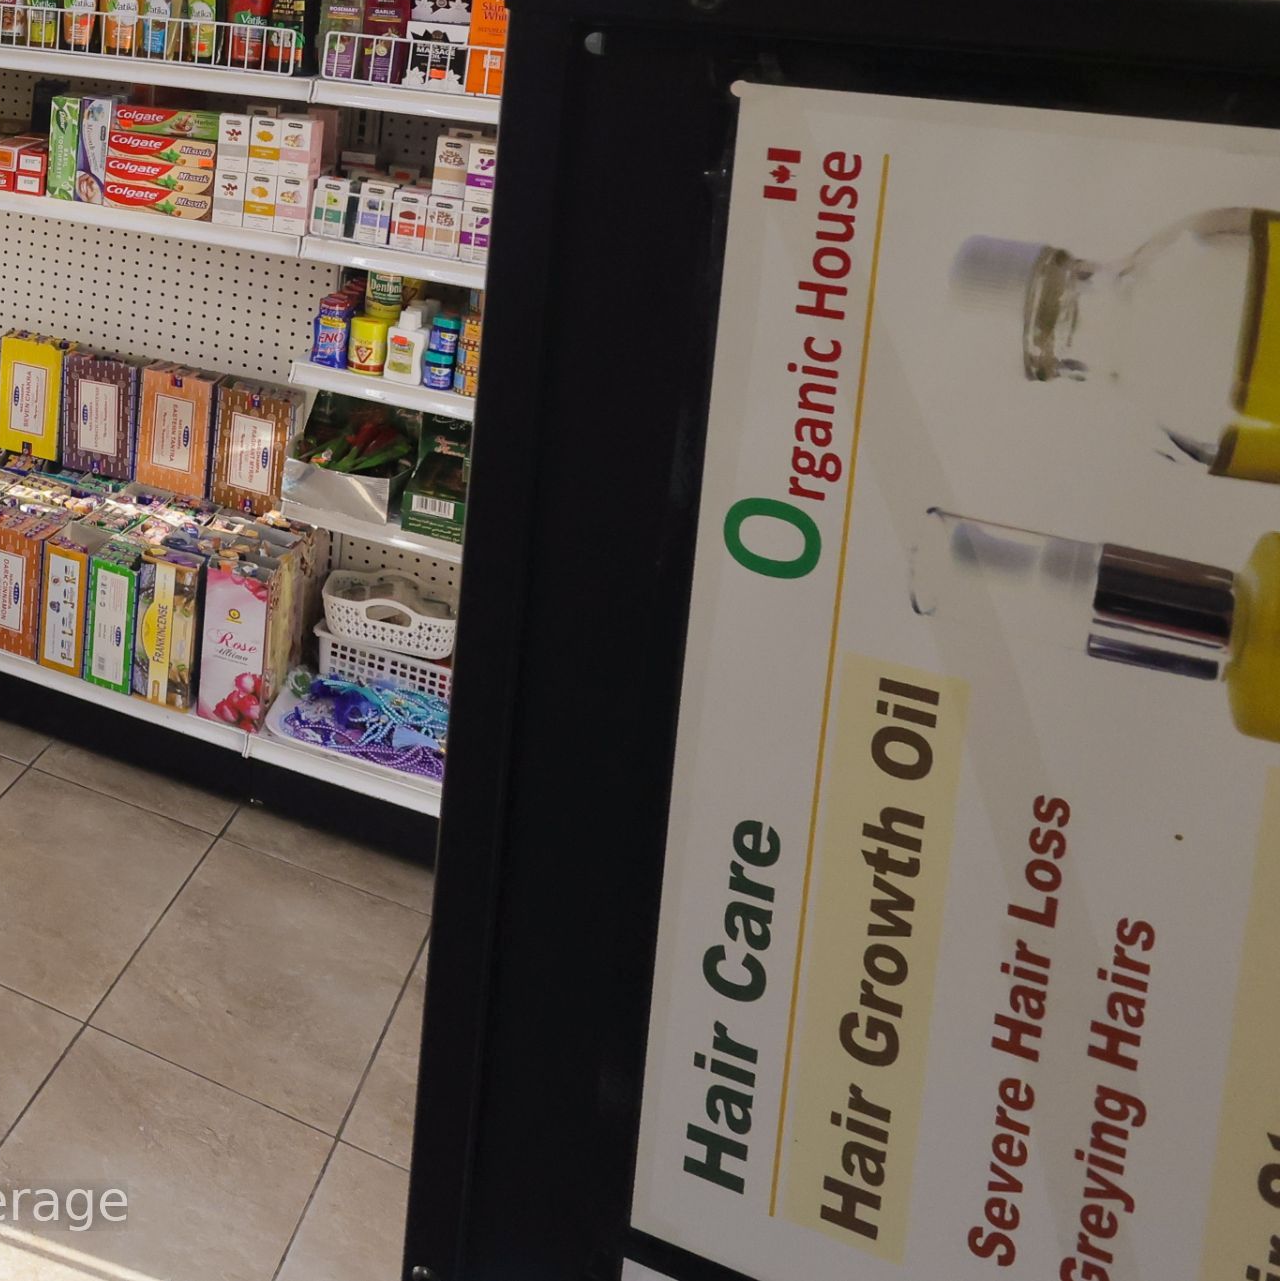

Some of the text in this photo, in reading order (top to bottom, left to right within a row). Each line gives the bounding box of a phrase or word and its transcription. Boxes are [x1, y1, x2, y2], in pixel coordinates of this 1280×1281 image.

[374, 8, 396, 16] GARLIC
[116, 108, 164, 123] Colgate
[111, 133, 162, 150] Colgate
[108, 159, 160, 176] Colgate
[106, 184, 158, 201] Colgate
[318, 332, 344, 344] ENO
[723, 150, 862, 579] Organic House
[152, 603, 169, 664] FRANKINCENSE
[217, 632, 258, 654] Rose
[820, 677, 940, 1240] Hair Growth Oil
[683, 819, 782, 1194] Hair Care
[968, 795, 1071, 1267] Severe Hair Loss
[1058, 917, 1156, 1281] Greying Hairs
